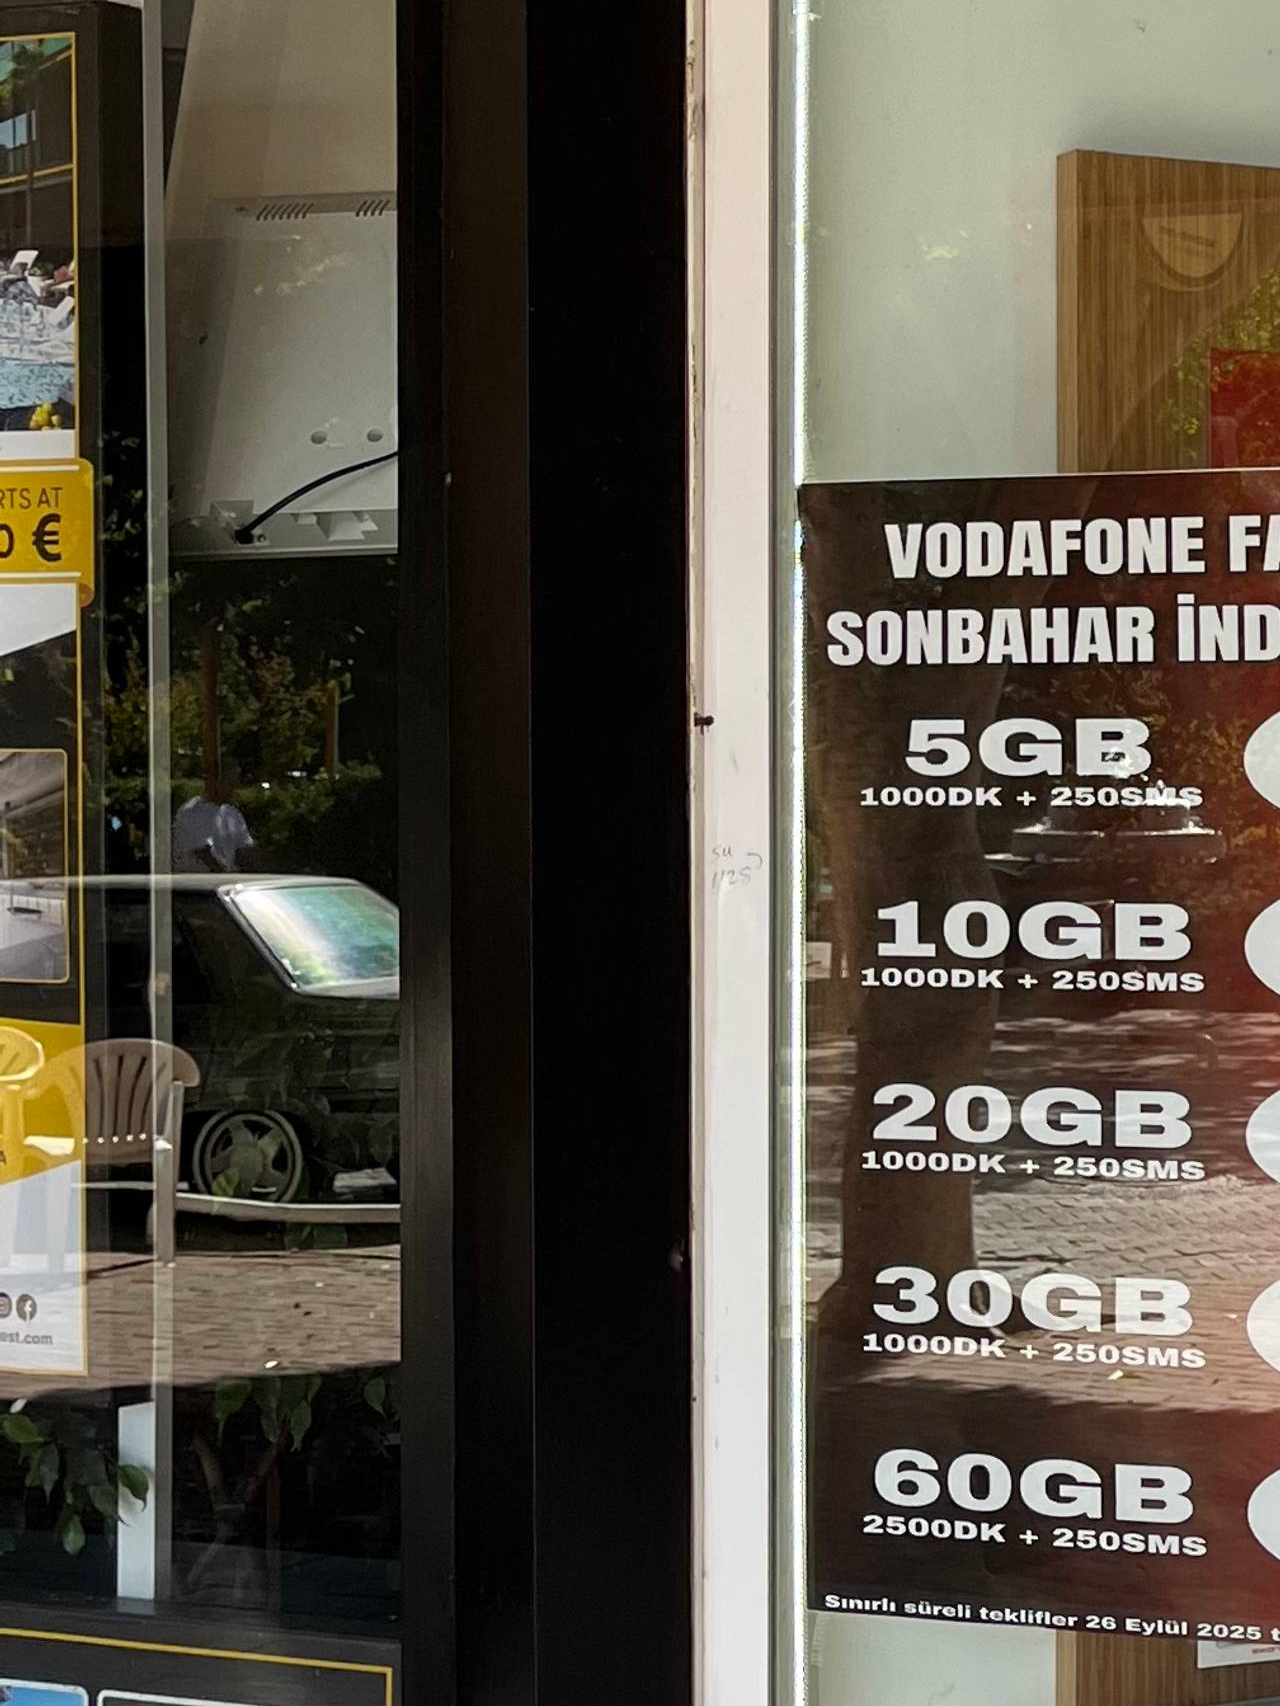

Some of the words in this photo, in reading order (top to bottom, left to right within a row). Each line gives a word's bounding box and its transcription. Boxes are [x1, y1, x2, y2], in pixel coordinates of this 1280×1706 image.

[36, 487, 63, 509] AT
[31, 512, 63, 564] €
[884, 515, 1204, 579] VODAFONE
[826, 604, 1155, 667] SONBAHAR
[905, 717, 1153, 777] 5GB
[860, 786, 1002, 807] 1000DK
[1016, 790, 1037, 806] +
[1049, 785, 1204, 808] 250SMS
[876, 899, 1192, 961] 10GB
[860, 968, 1005, 988] 1000DK
[1017, 971, 1037, 989] +
[1053, 968, 1204, 993] 250SMS
[872, 1082, 1193, 1149] 20GB
[861, 1150, 1006, 1174] 1000DK
[1020, 1158, 1040, 1175] +
[1053, 1155, 1206, 1181] 250SMS
[872, 1266, 1194, 1337] 30GB
[862, 1332, 1006, 1357] 1000DK
[1019, 1341, 1040, 1360] +
[1052, 1342, 1207, 1369] 250SMS
[873, 1447, 1195, 1523] 60GB
[862, 1514, 1006, 1543] 2500DK
[1018, 1527, 1039, 1546] +
[1052, 1526, 1208, 1557] 250SMS
[824, 1593, 897, 1613] Sınırlı
[903, 1600, 972, 1620] süreli
[978, 1606, 1079, 1628] teklifler
[1085, 1614, 1117, 1631] 26
[1124, 1616, 1188, 1638] Eylül
[1197, 1623, 1262, 1641] 2025
